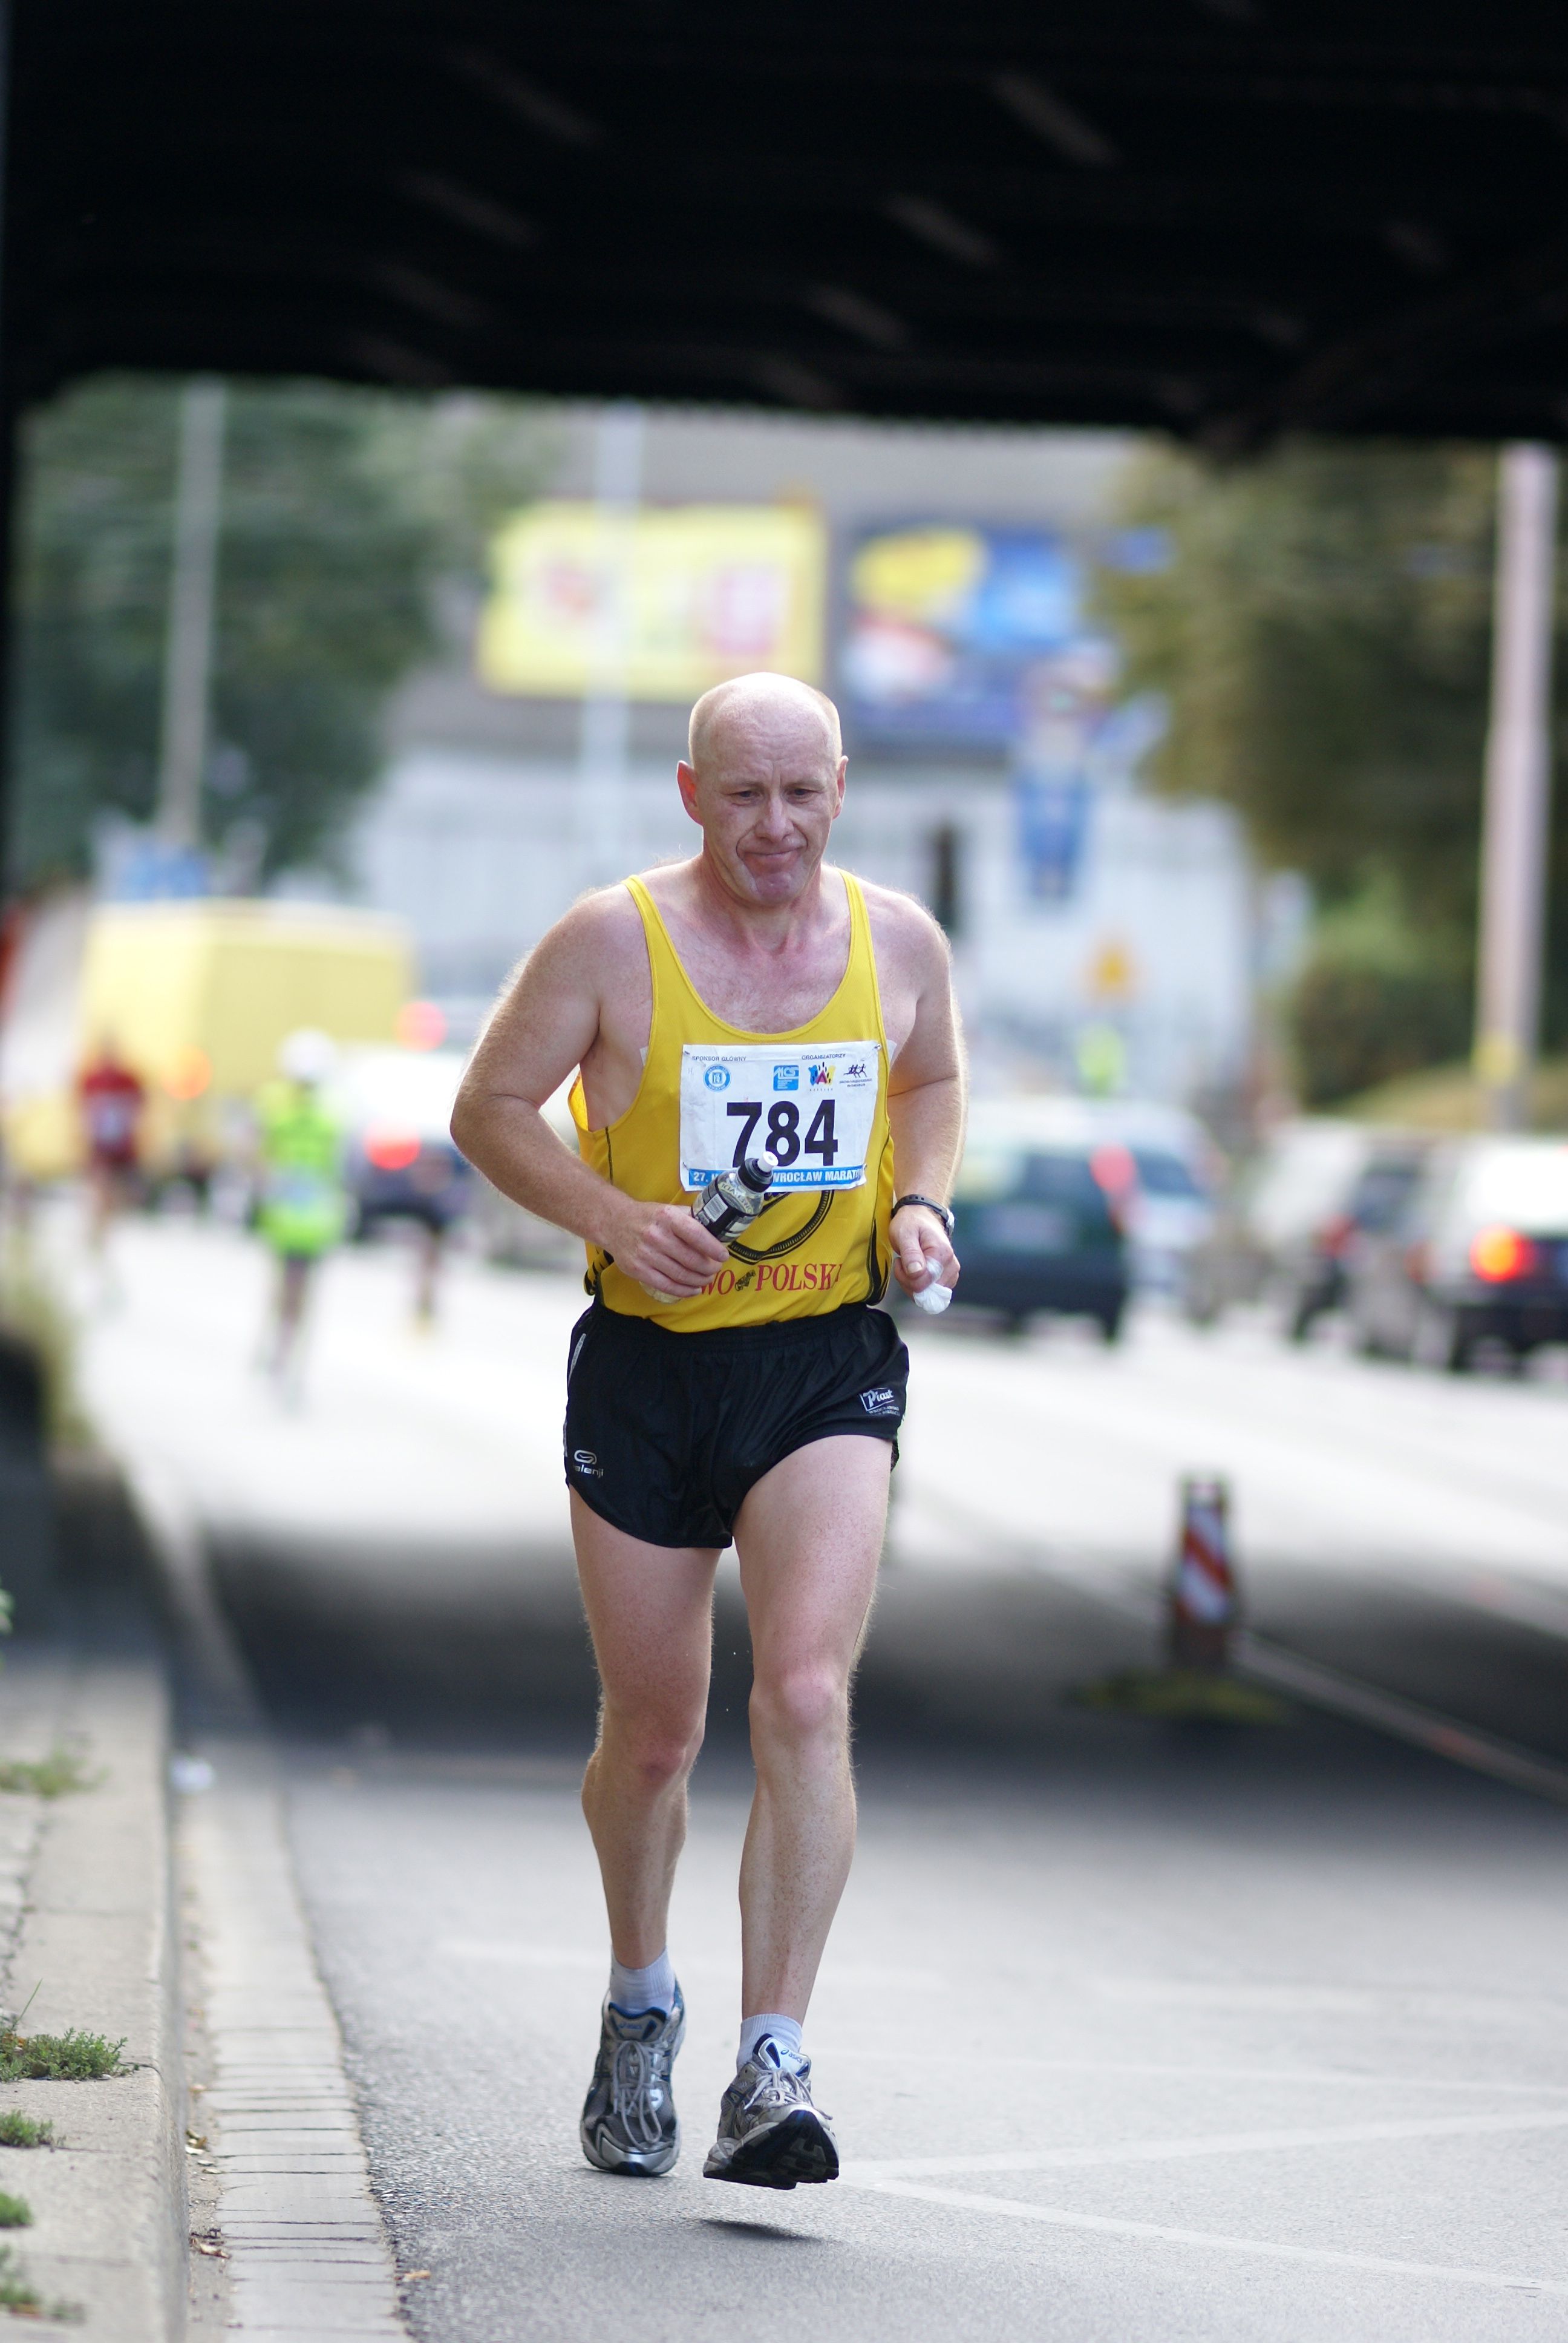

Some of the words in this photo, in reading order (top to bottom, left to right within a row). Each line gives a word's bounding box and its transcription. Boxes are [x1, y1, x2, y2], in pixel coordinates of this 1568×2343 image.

[727, 1099, 838, 1168] 784
[693, 1172, 708, 1183] 27.
[773, 1171, 823, 1182] WROCŁAW
